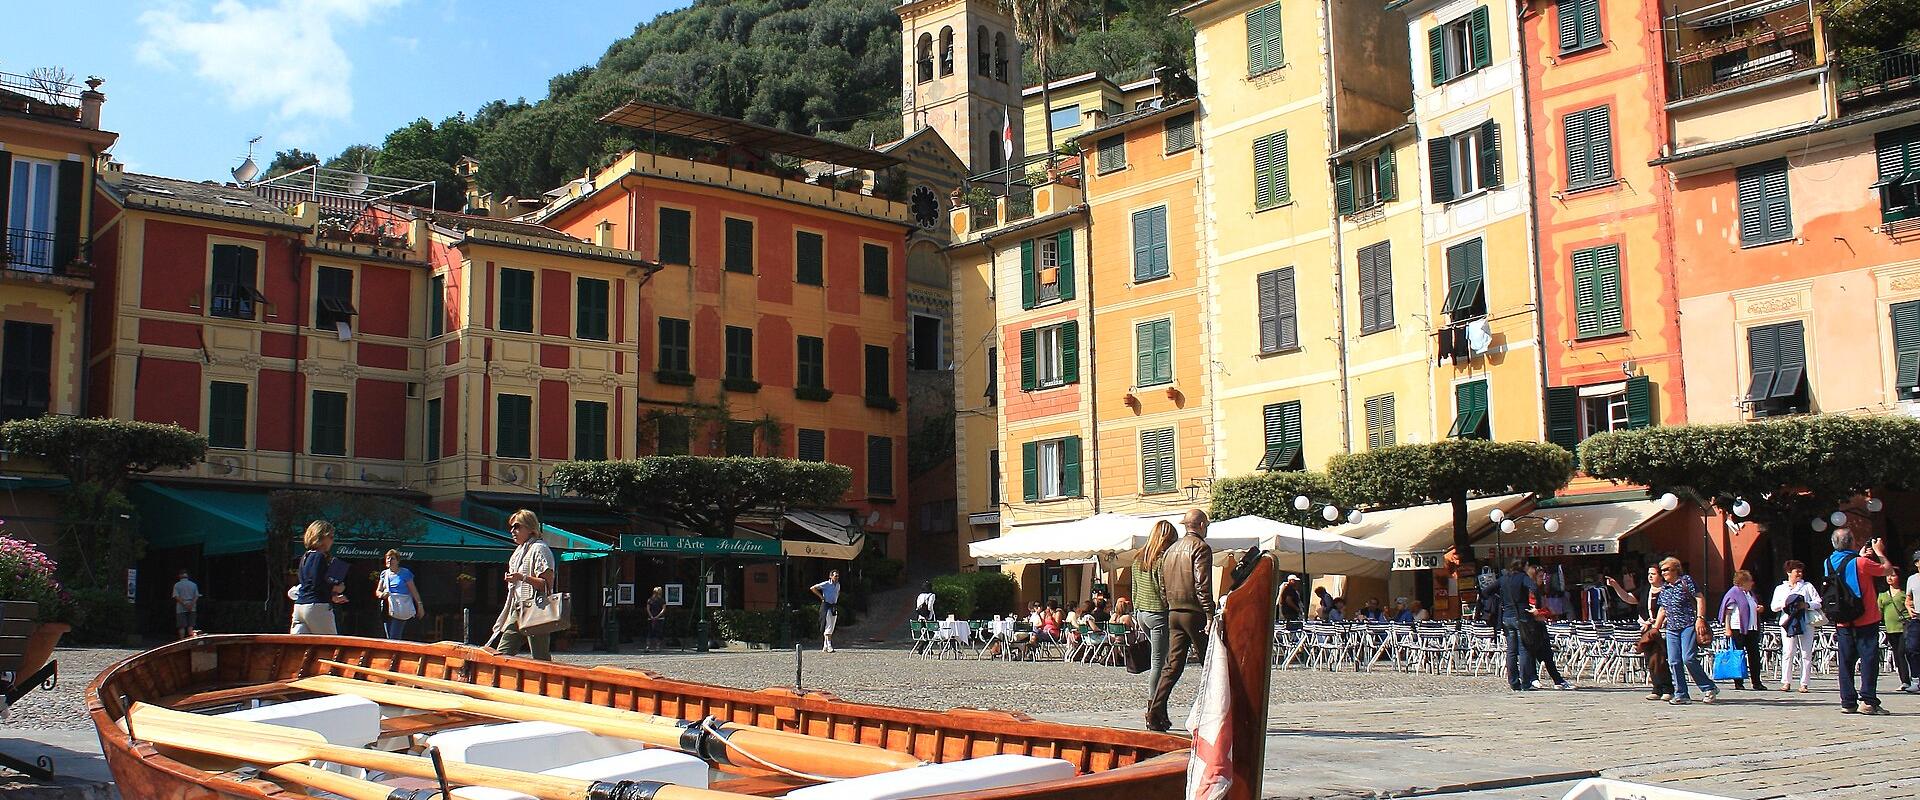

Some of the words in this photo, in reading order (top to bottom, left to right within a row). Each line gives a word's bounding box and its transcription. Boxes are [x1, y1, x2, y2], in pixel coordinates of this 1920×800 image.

[336, 545, 380, 556] Ristorante
[633, 537, 669, 548] Galleria
[676, 538, 705, 549] d'Arte
[716, 539, 763, 552] Portofino
[1488, 544, 1565, 560] SOUVENIRS
[1569, 543, 1605, 554] GAIES
[1397, 557, 1411, 568] DA
